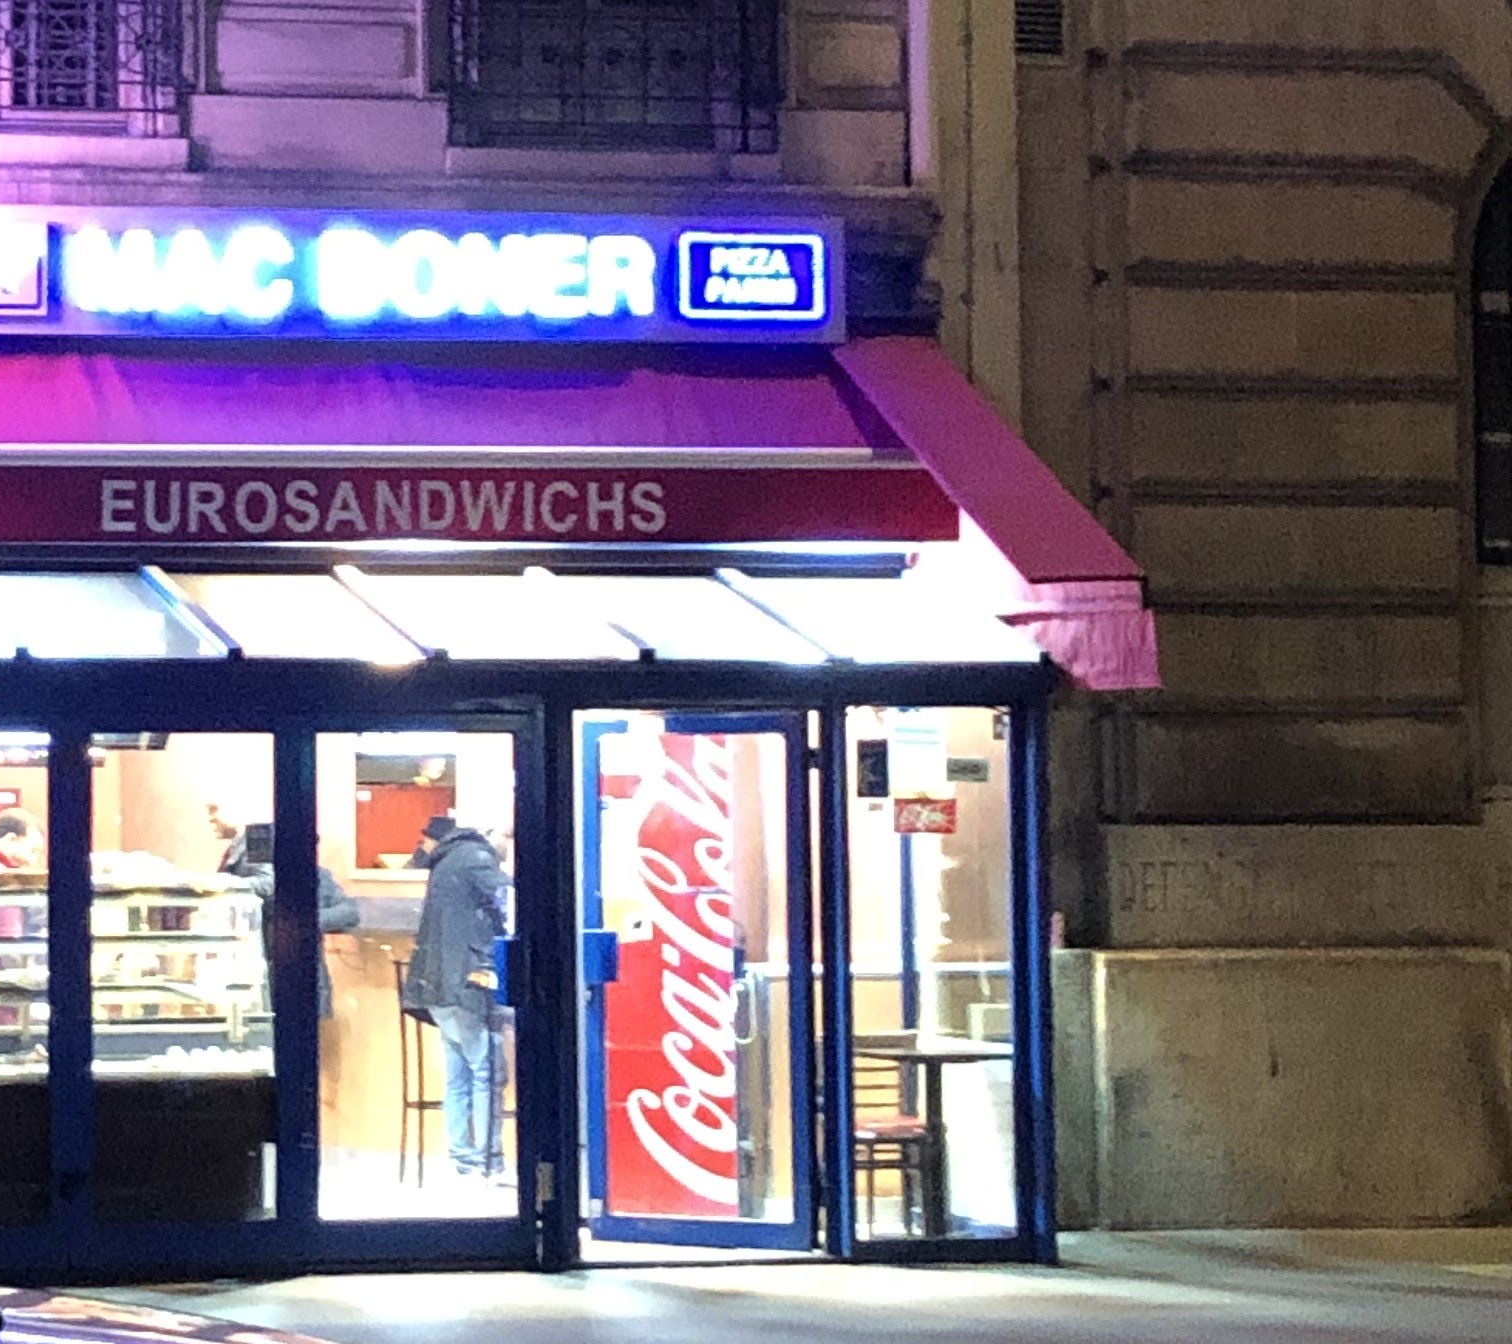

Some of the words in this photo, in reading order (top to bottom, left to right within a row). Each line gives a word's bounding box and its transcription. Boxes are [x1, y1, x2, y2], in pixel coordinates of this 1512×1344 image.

[66, 224, 295, 320] MAC
[710, 247, 790, 275] PIZZA
[704, 276, 798, 305] PAN
[99, 478, 668, 534] EUROSANDWICHS
